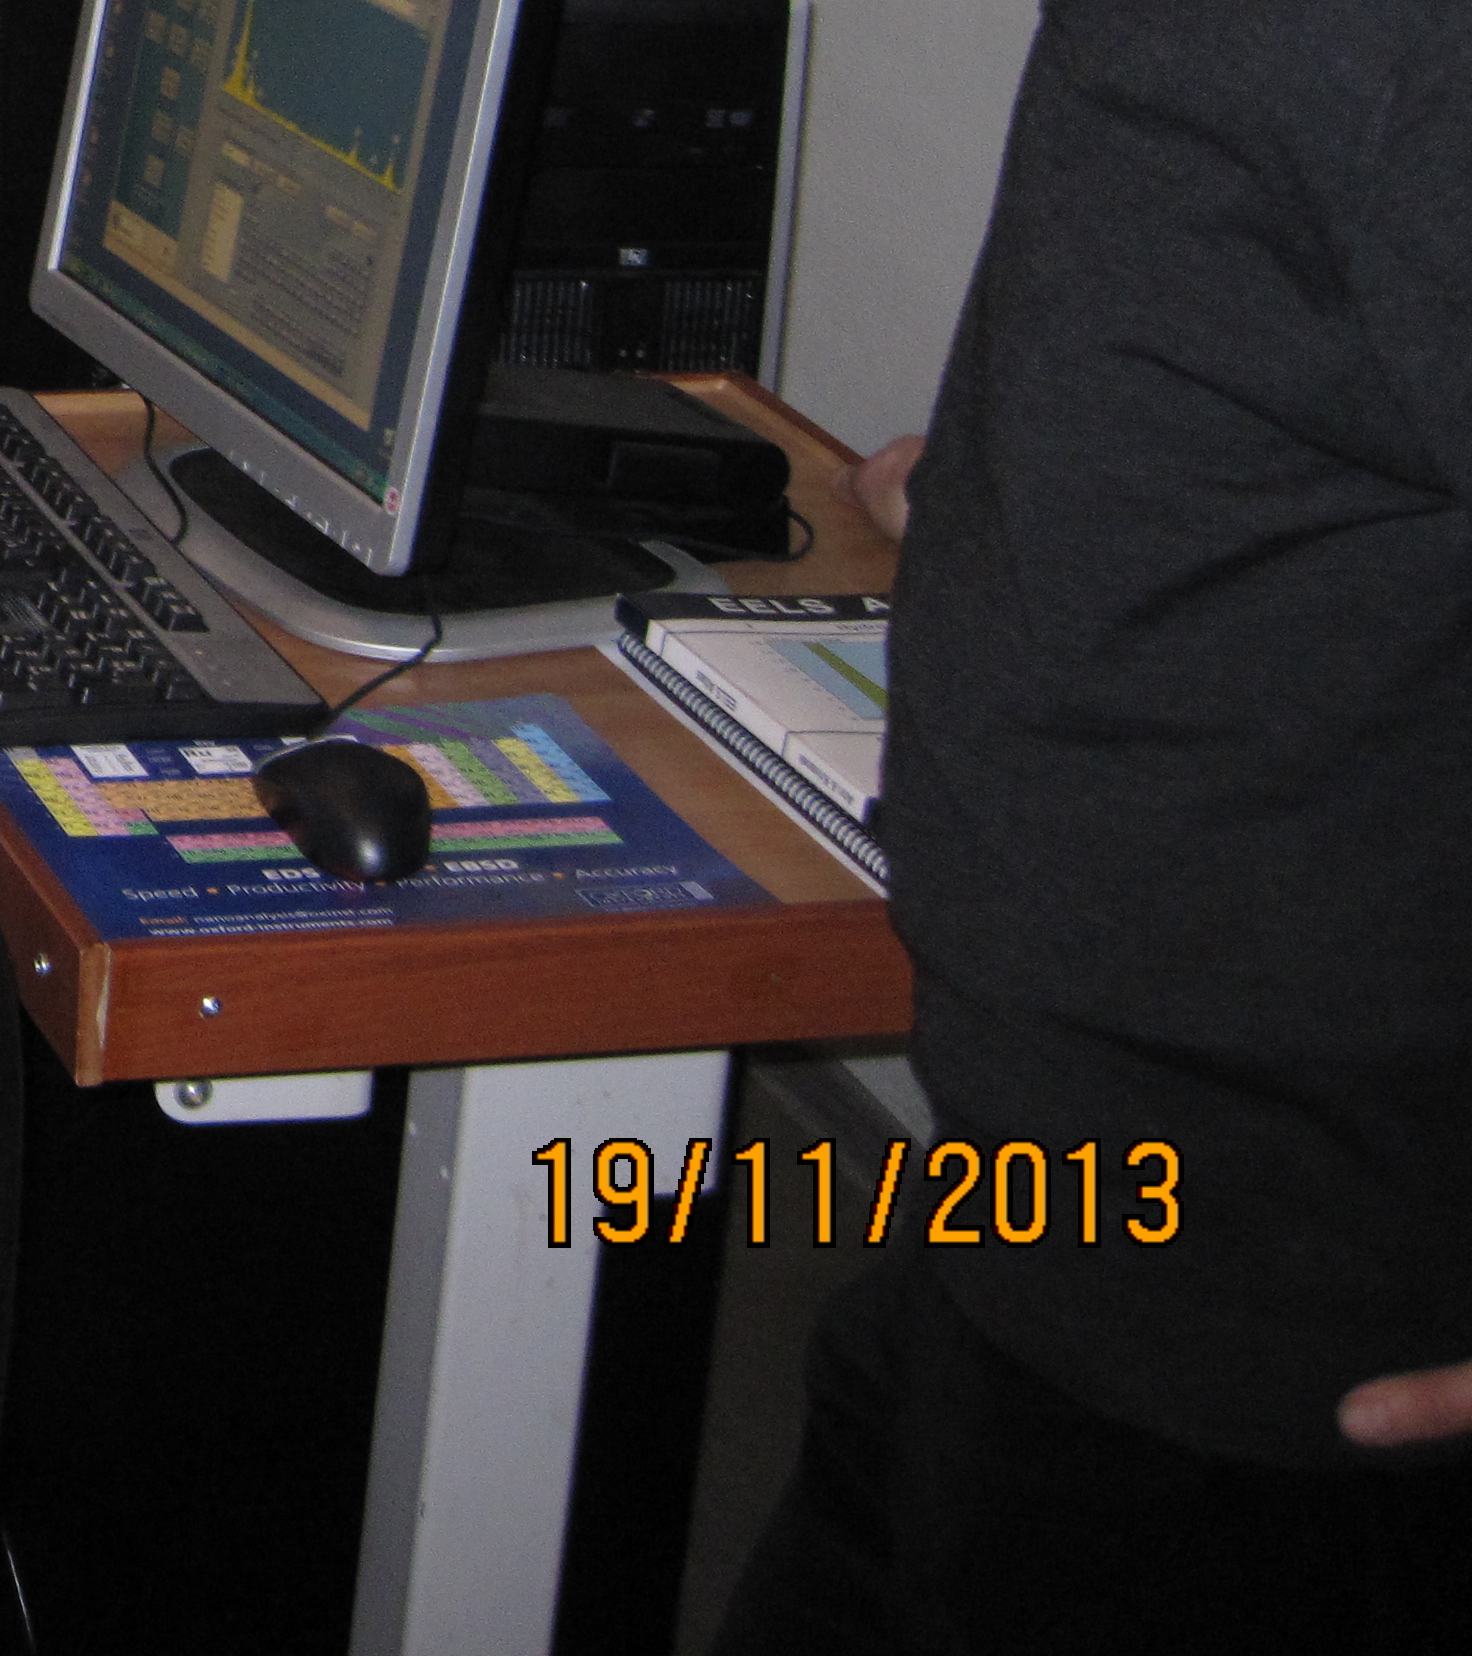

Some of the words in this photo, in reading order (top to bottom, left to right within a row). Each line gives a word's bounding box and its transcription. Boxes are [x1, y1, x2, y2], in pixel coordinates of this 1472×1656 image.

[707, 597, 837, 615] EELS
[442, 858, 519, 873] EBSD
[122, 885, 200, 903] Speed
[226, 877, 366, 897] Productivity
[396, 872, 546, 891] Performance
[574, 864, 678, 881] Accuracy
